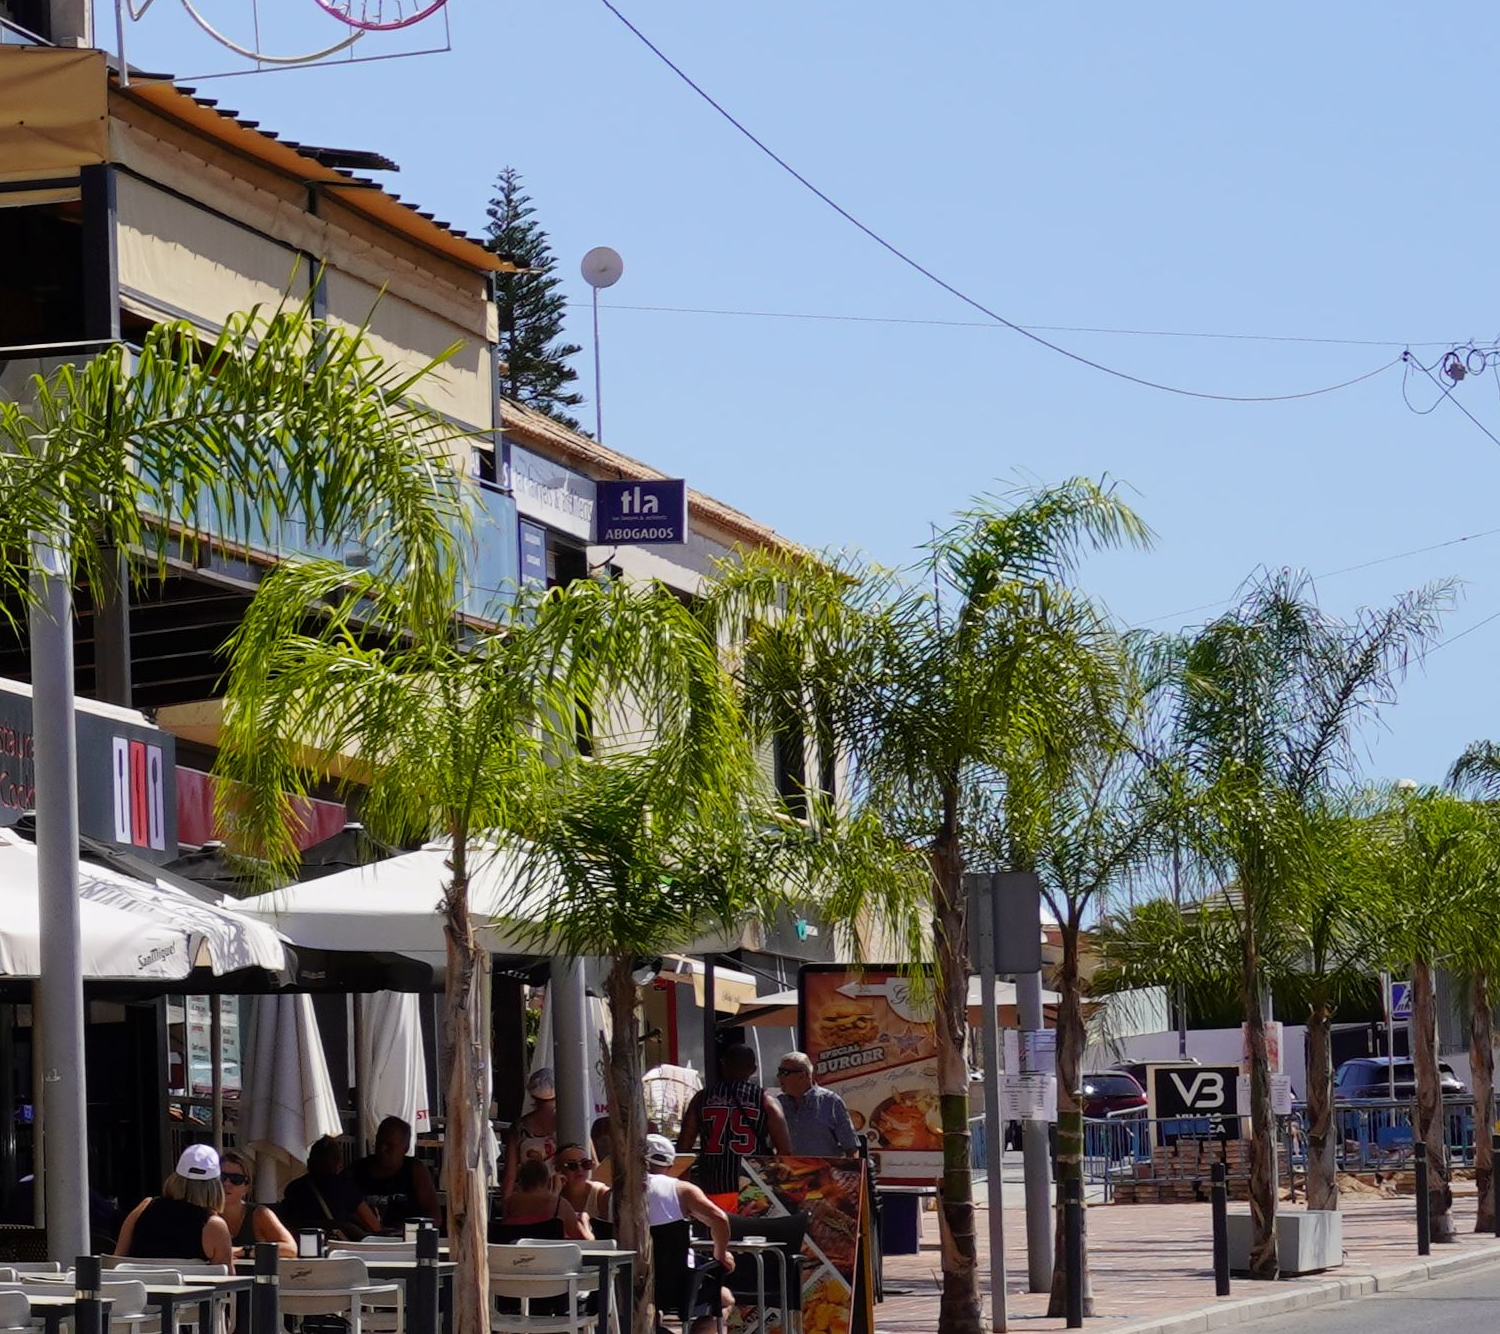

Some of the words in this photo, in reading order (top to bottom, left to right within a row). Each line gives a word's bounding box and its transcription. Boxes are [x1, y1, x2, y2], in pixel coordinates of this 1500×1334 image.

[620, 486, 659, 515] tla
[604, 527, 675, 541] ABOGADOS
[0, 770, 37, 812] Cock
[816, 1047, 885, 1075] BURGER
[819, 1044, 861, 1060] SPECIAL
[702, 1107, 760, 1155] 75
